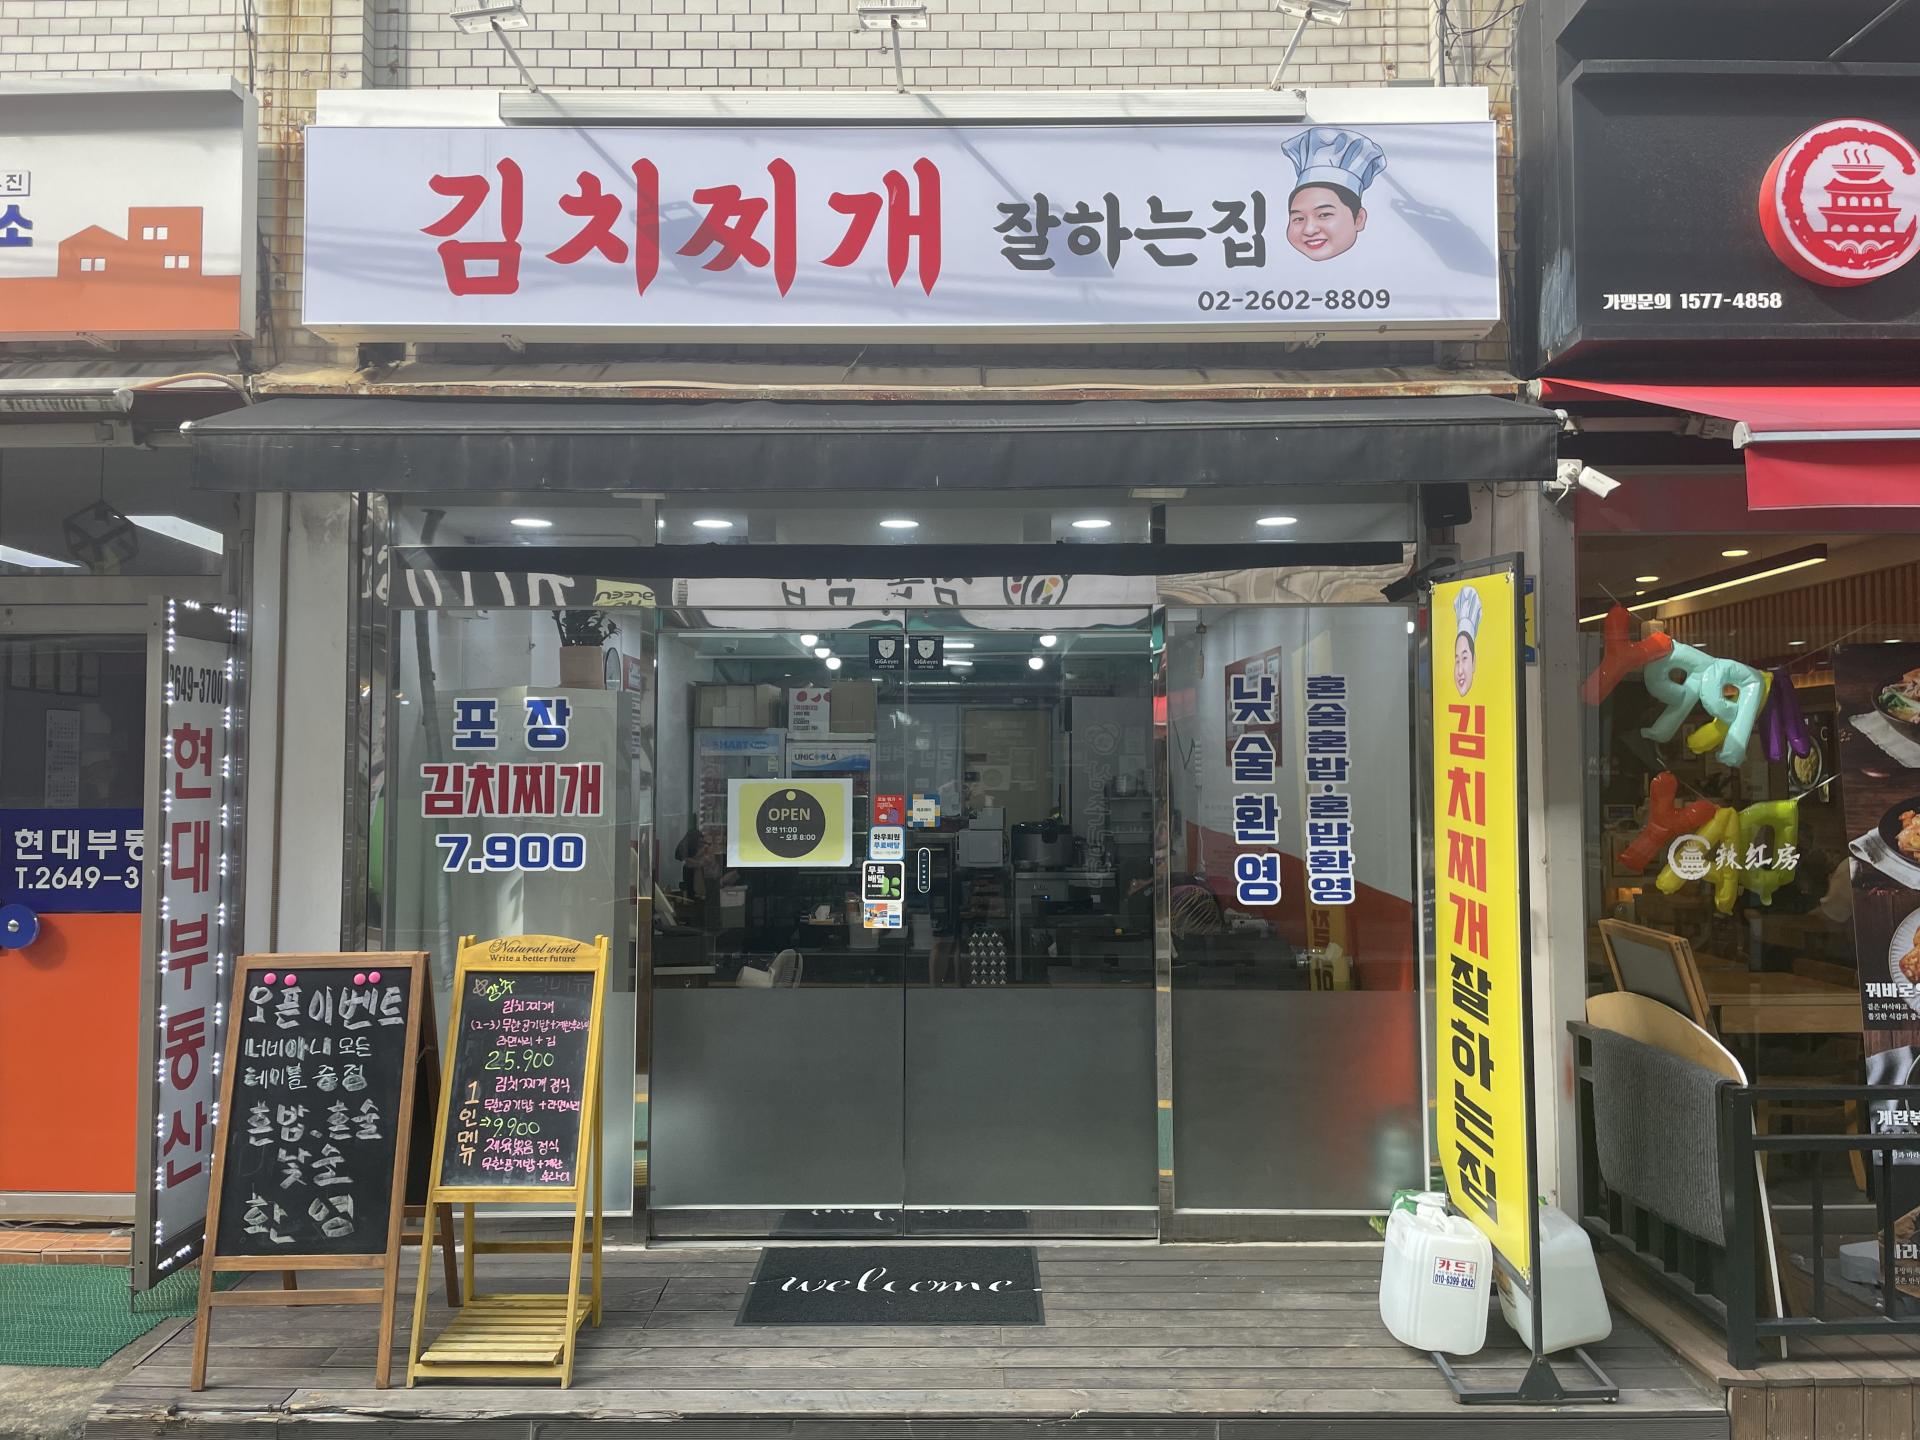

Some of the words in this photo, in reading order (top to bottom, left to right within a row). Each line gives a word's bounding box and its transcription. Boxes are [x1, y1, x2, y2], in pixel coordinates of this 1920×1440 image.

[0, 174, 22, 191] 진
[419, 156, 942, 298] 김치찌개
[993, 190, 1267, 271] 잘하는집
[1197, 288, 1391, 311] 02-2602-8809
[1602, 293, 1671, 310] 가맹문의
[1679, 292, 1783, 309] 1577-4858
[422, 764, 603, 817] 김치찌개
[768, 808, 811, 821] OPEN
[1447, 704, 1489, 960] 김치찌개
[437, 833, 586, 873] 7.900
[15, 866, 140, 890] T.2649-3
[164, 722, 213, 1189] 현대부동산
[488, 938, 546, 954] Natural
[547, 943, 581, 954] wind
[490, 954, 514, 962] Write
[522, 954, 548, 962] better
[549, 954, 576, 962] future
[502, 998, 555, 1014] 김치찌개
[338, 1036, 372, 1057] 모든
[545, 1036, 556, 1047] 김
[484, 1049, 555, 1072] 25.900
[312, 1064, 368, 1092] 증정
[495, 1075, 547, 1093] 김치찌개
[549, 1077, 571, 1094] 정식
[1450, 953, 1498, 1225] 잘하는집
[537, 1138, 560, 1156] 정식
[243, 1192, 355, 1244] 환영
[1438, 1259, 1466, 1273] 카드
[781, 1267, 1013, 1293] welcome
